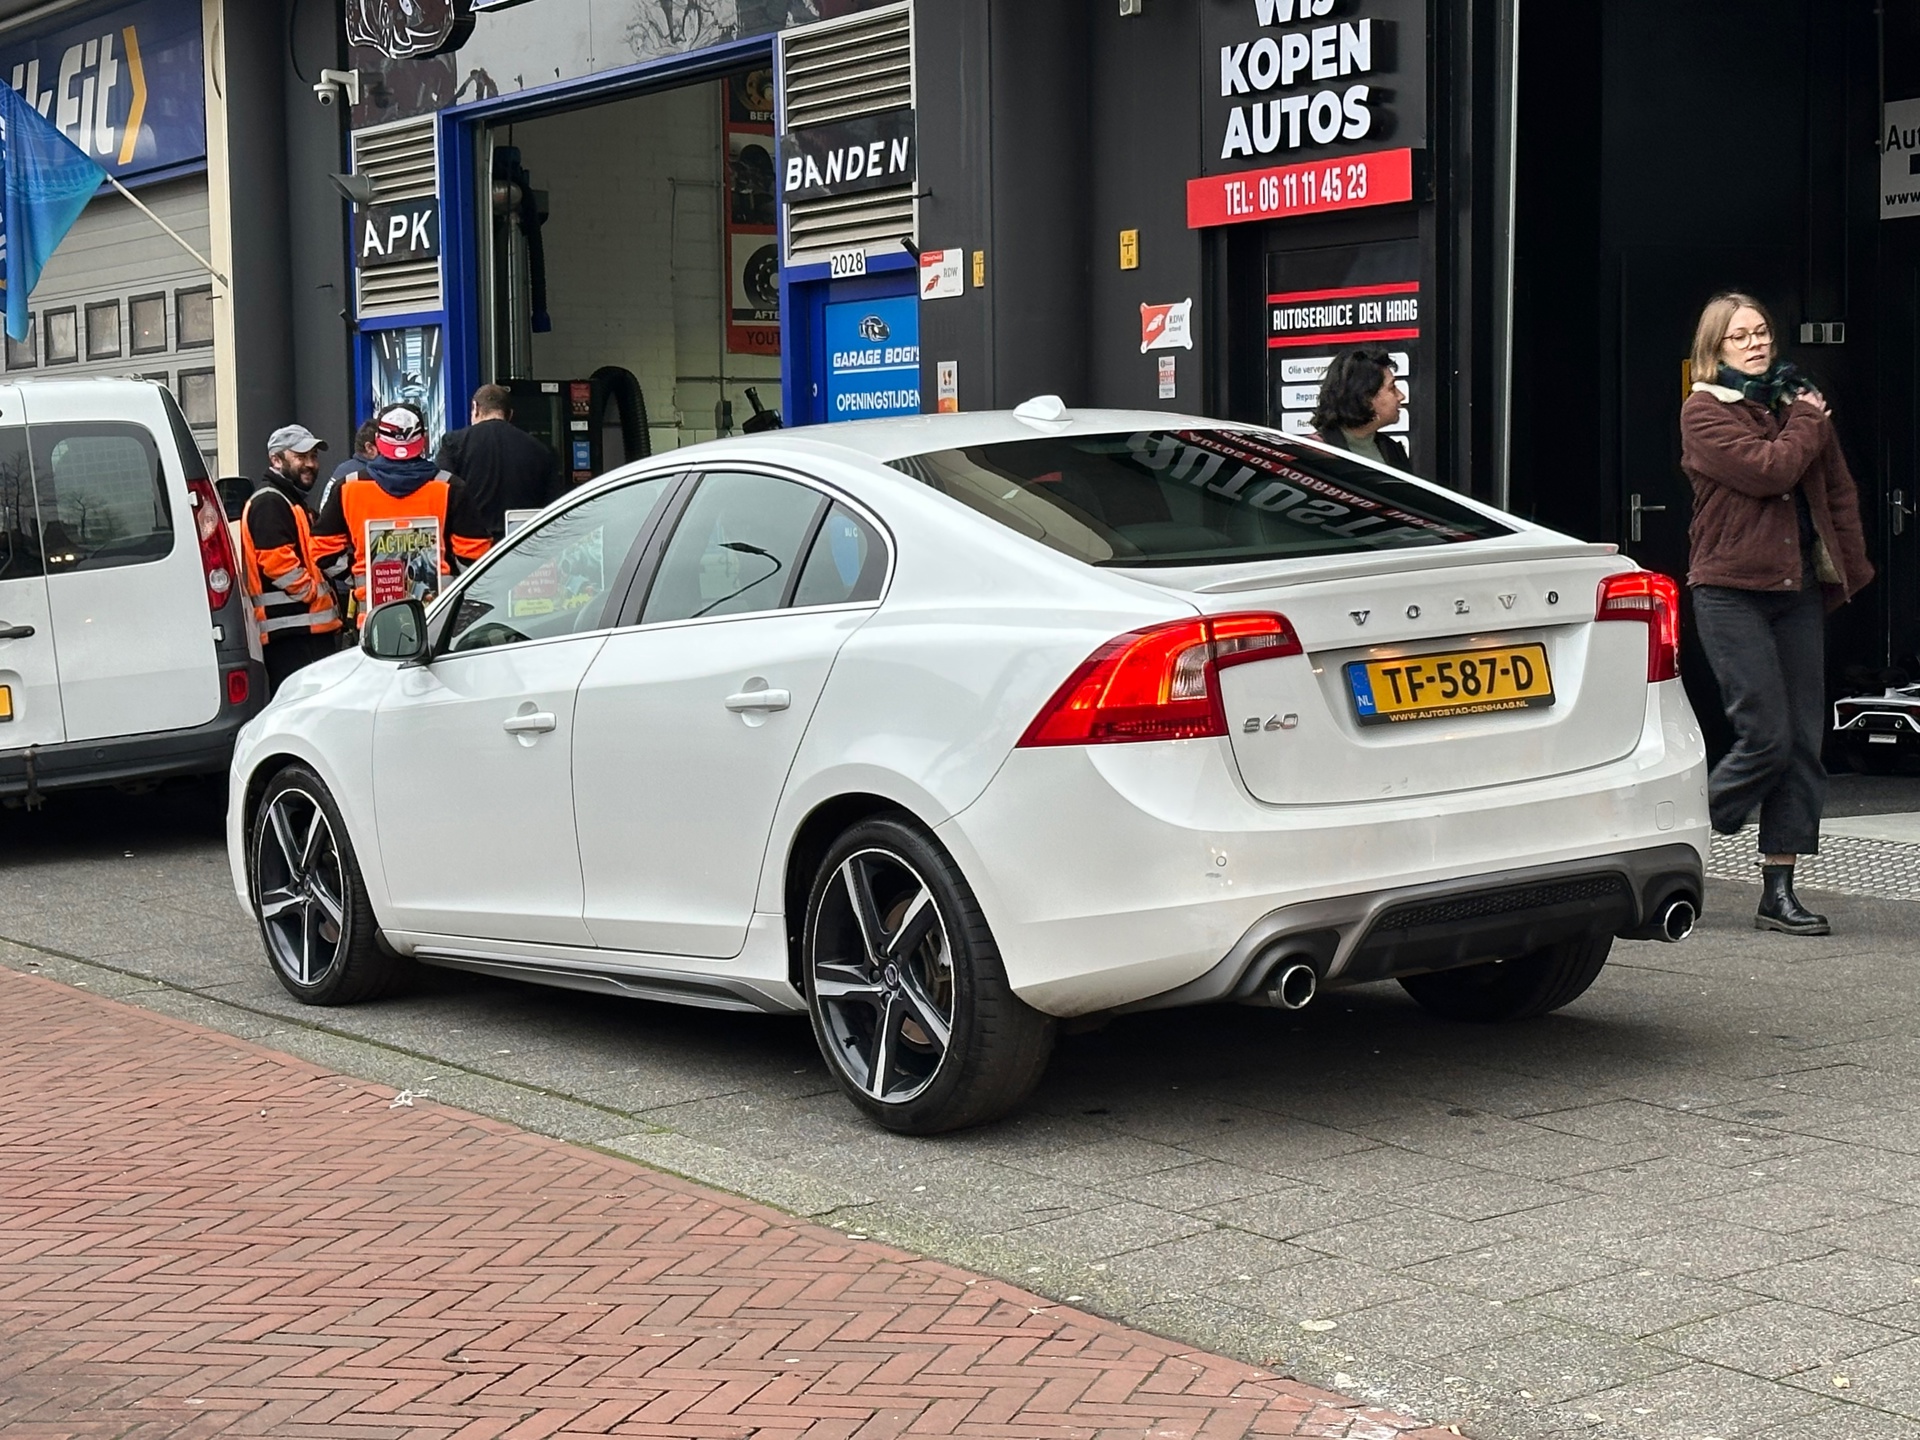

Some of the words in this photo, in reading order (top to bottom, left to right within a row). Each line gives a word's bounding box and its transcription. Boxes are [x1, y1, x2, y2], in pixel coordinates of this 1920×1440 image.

[1221, 18, 1371, 96] KOPEN
[1221, 85, 1371, 159] AUTOS
[785, 136, 909, 191] BANDEN
[1225, 181, 1254, 215] TEL:
[1259, 175, 1279, 212] 06
[1283, 173, 1297, 208] 11
[1301, 171, 1316, 205] 11
[1321, 167, 1342, 202] 45
[1346, 163, 1368, 200] 23
[363, 210, 432, 257] APK
[832, 252, 863, 275] 2028
[1273, 304, 1353, 331] AUTOSERVICE
[1359, 302, 1382, 325] DEN
[1386, 299, 1418, 322] HAAG
[833, 349, 881, 367] GARAGE
[836, 389, 920, 411] OPENINGSTIJDEN
[1349, 591, 1560, 626] VOLVO
[1382, 655, 1533, 704] TF-587-D
[1357, 694, 1373, 707] NL
[1243, 713, 1299, 733] S60
